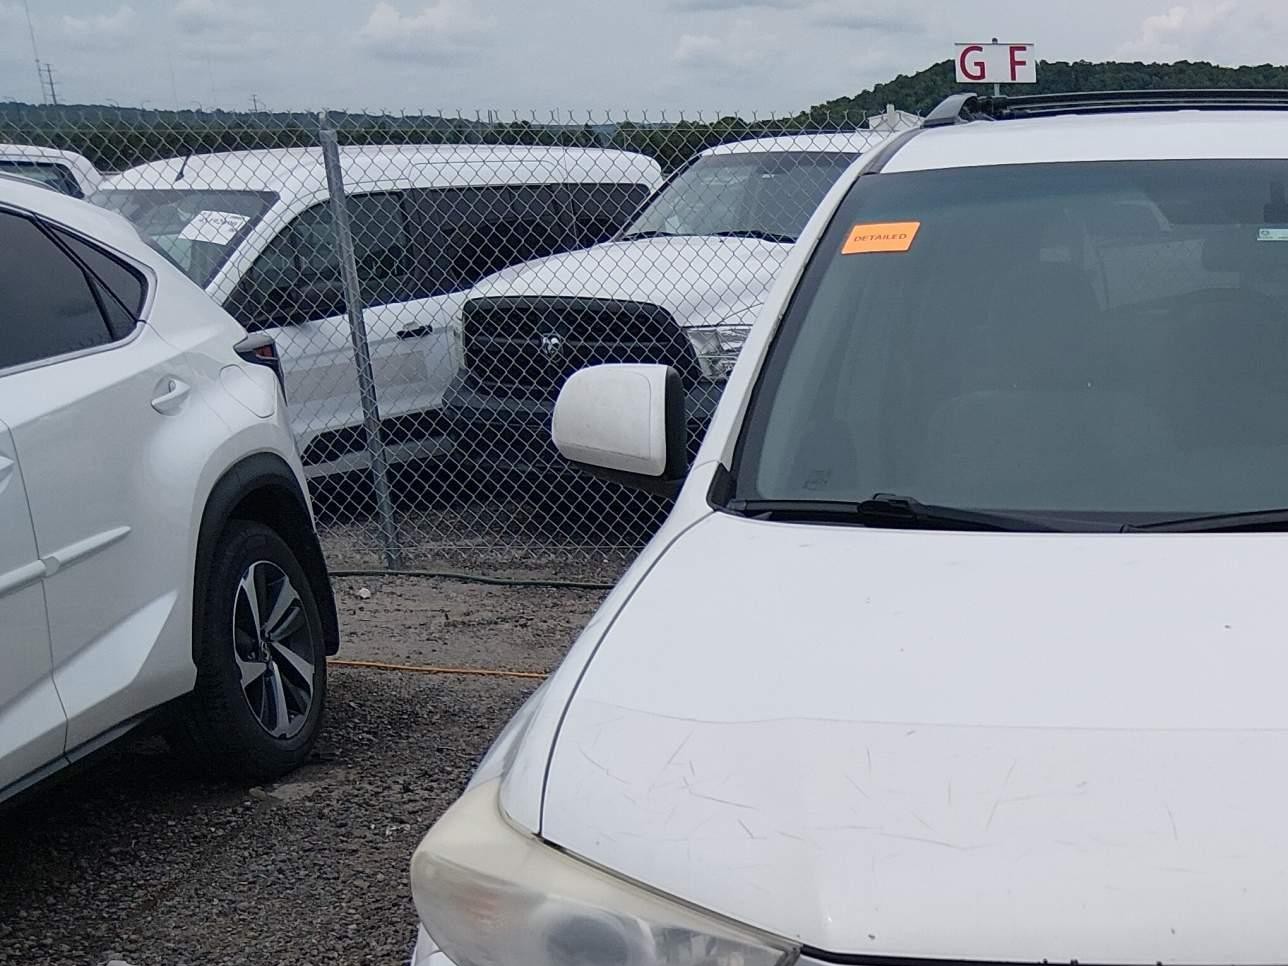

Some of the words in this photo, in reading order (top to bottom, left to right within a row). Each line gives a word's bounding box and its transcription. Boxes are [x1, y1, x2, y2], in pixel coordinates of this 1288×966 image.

[960, 46, 986, 81] G
[1009, 46, 1027, 81] F
[854, 233, 908, 242] DETAILED
